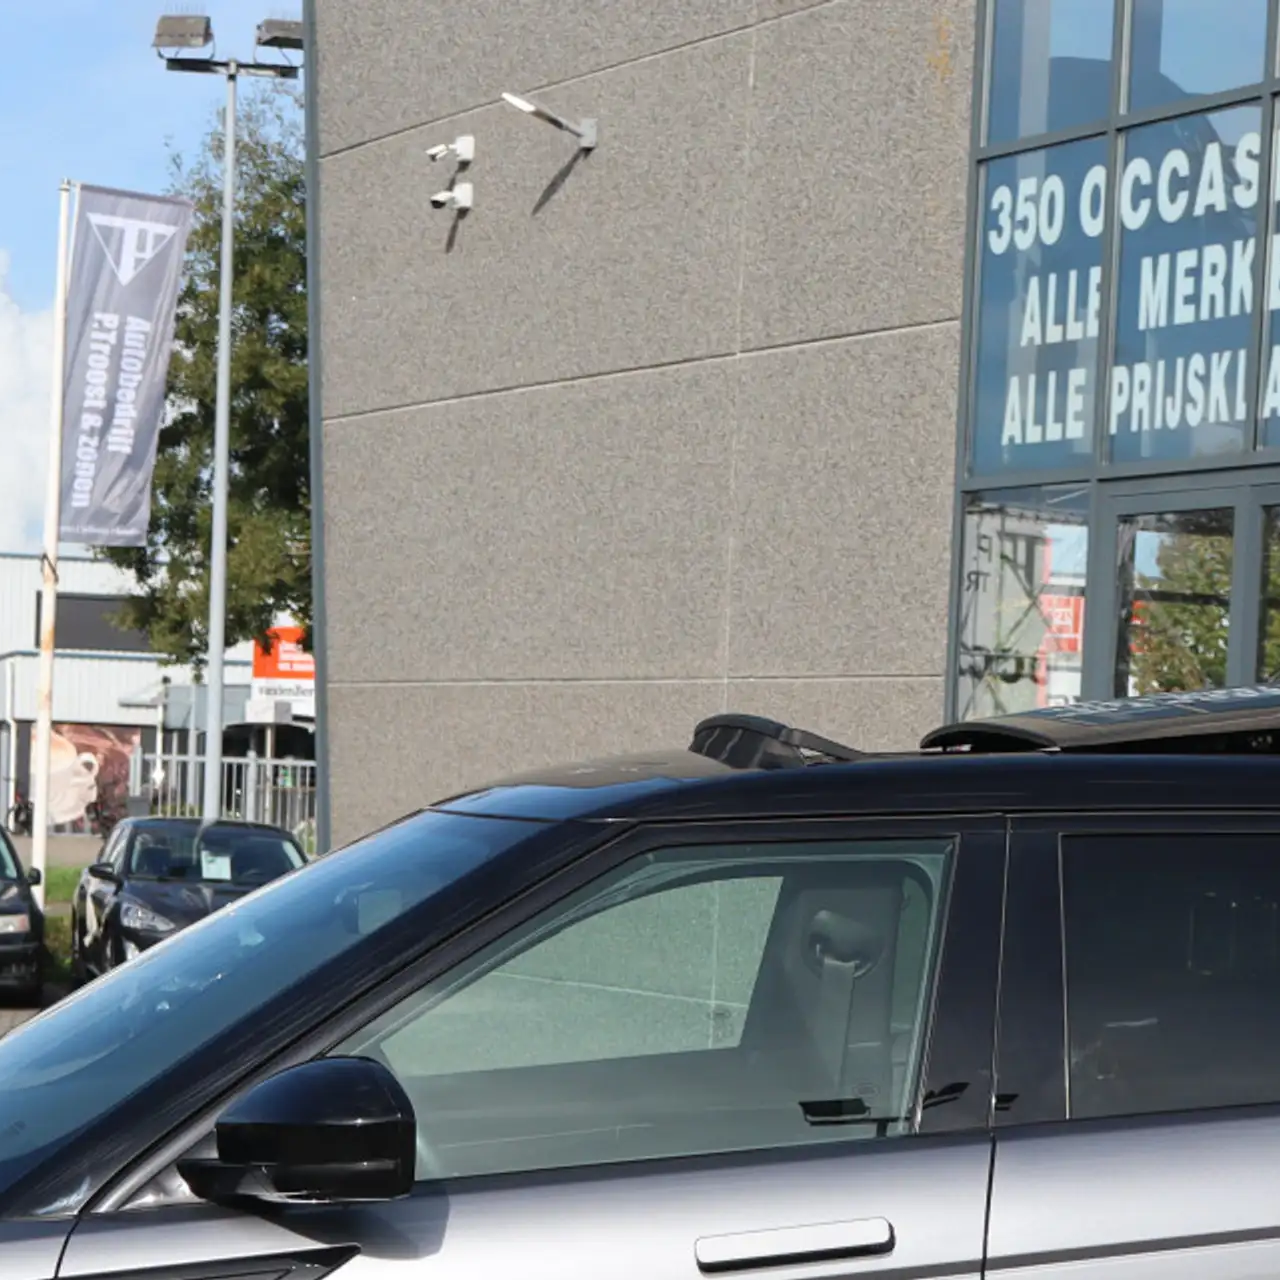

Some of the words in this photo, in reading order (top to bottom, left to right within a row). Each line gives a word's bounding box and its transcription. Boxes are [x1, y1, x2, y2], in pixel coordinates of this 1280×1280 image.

[988, 174, 1063, 256] 350
[1020, 266, 1102, 348] ALLE
[81, 411, 104, 432] &
[107, 316, 152, 454] Autobedrijf
[1001, 368, 1087, 447] ALLE
